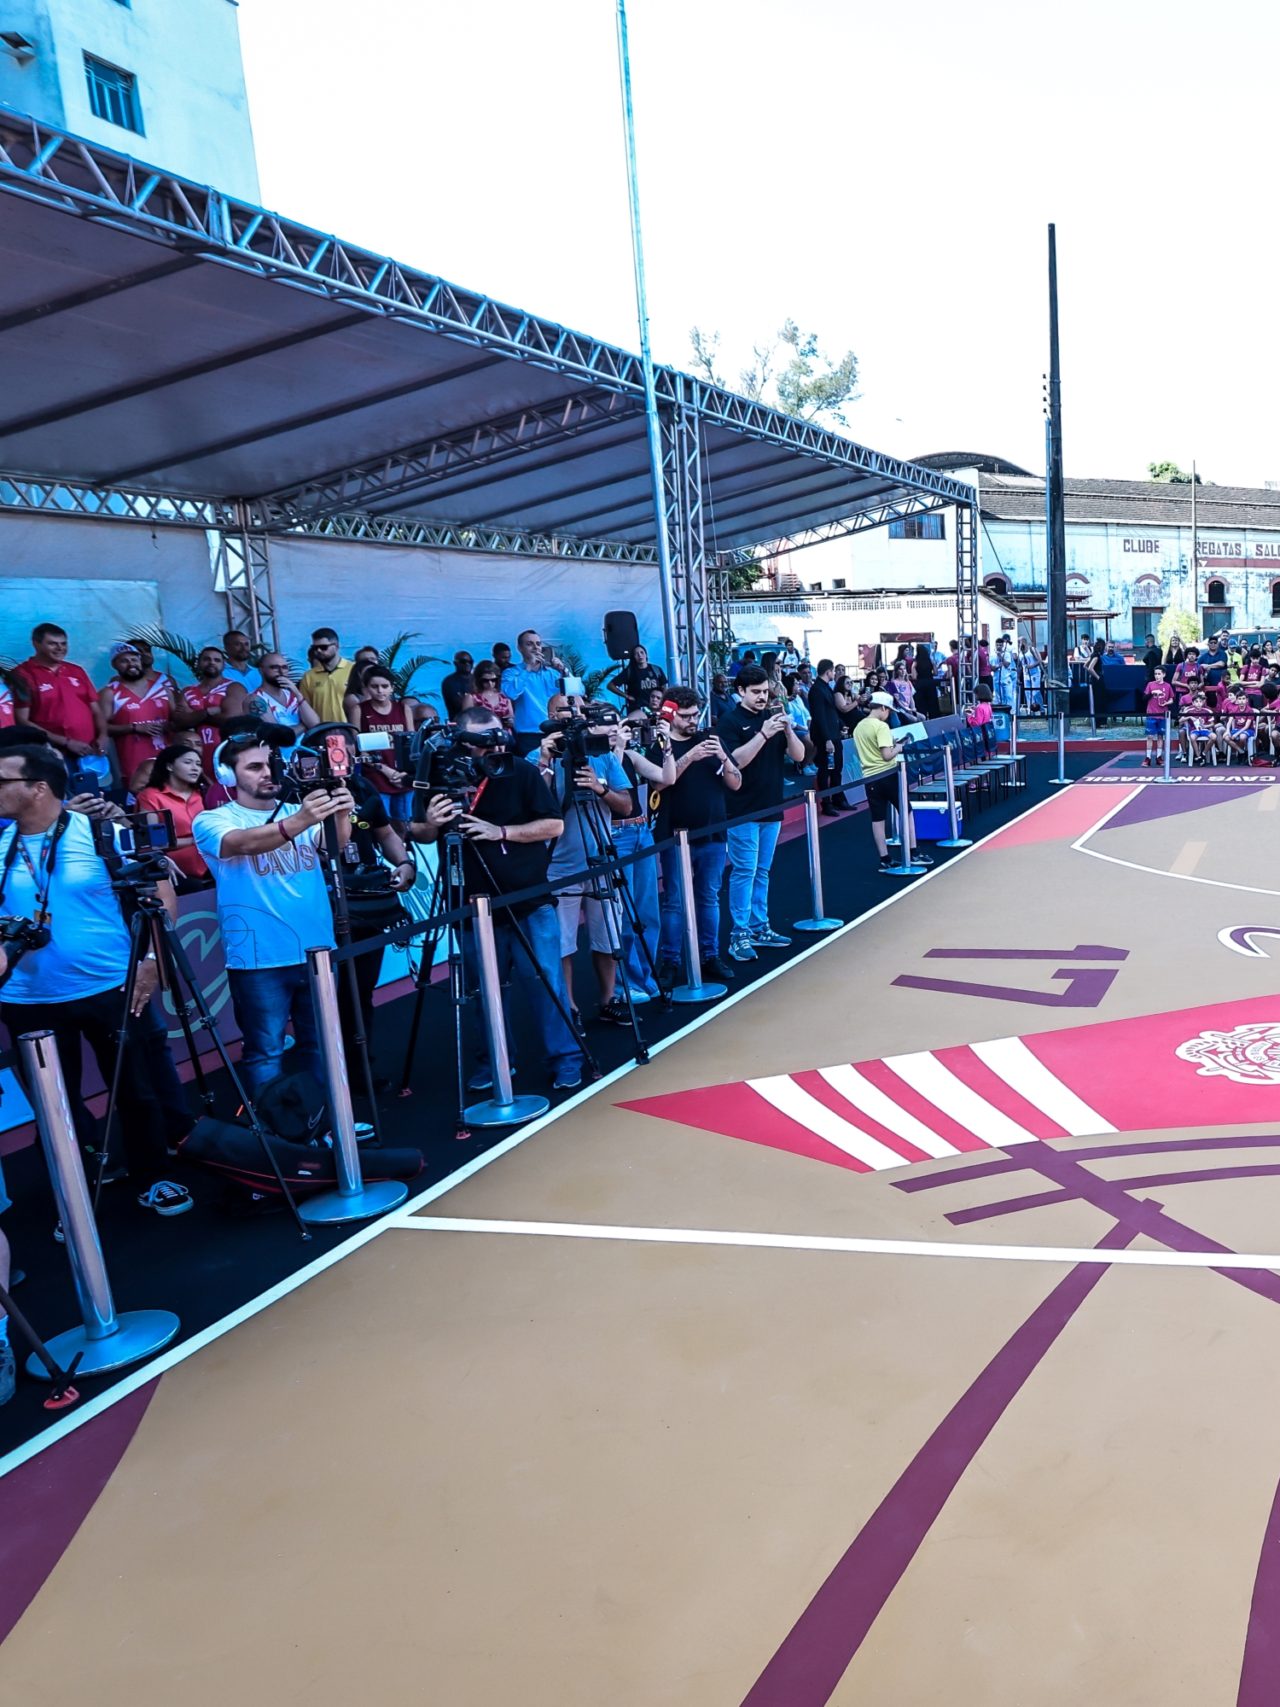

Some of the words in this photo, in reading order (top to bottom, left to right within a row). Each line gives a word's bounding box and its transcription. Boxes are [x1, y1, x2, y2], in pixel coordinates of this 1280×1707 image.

[1123, 539, 1160, 553] CLUBE
[641, 677, 657, 690] AVS
[369, 723, 404, 733] CLEVELAND
[201, 727, 214, 744] 12
[252, 842, 314, 876] CAVS
